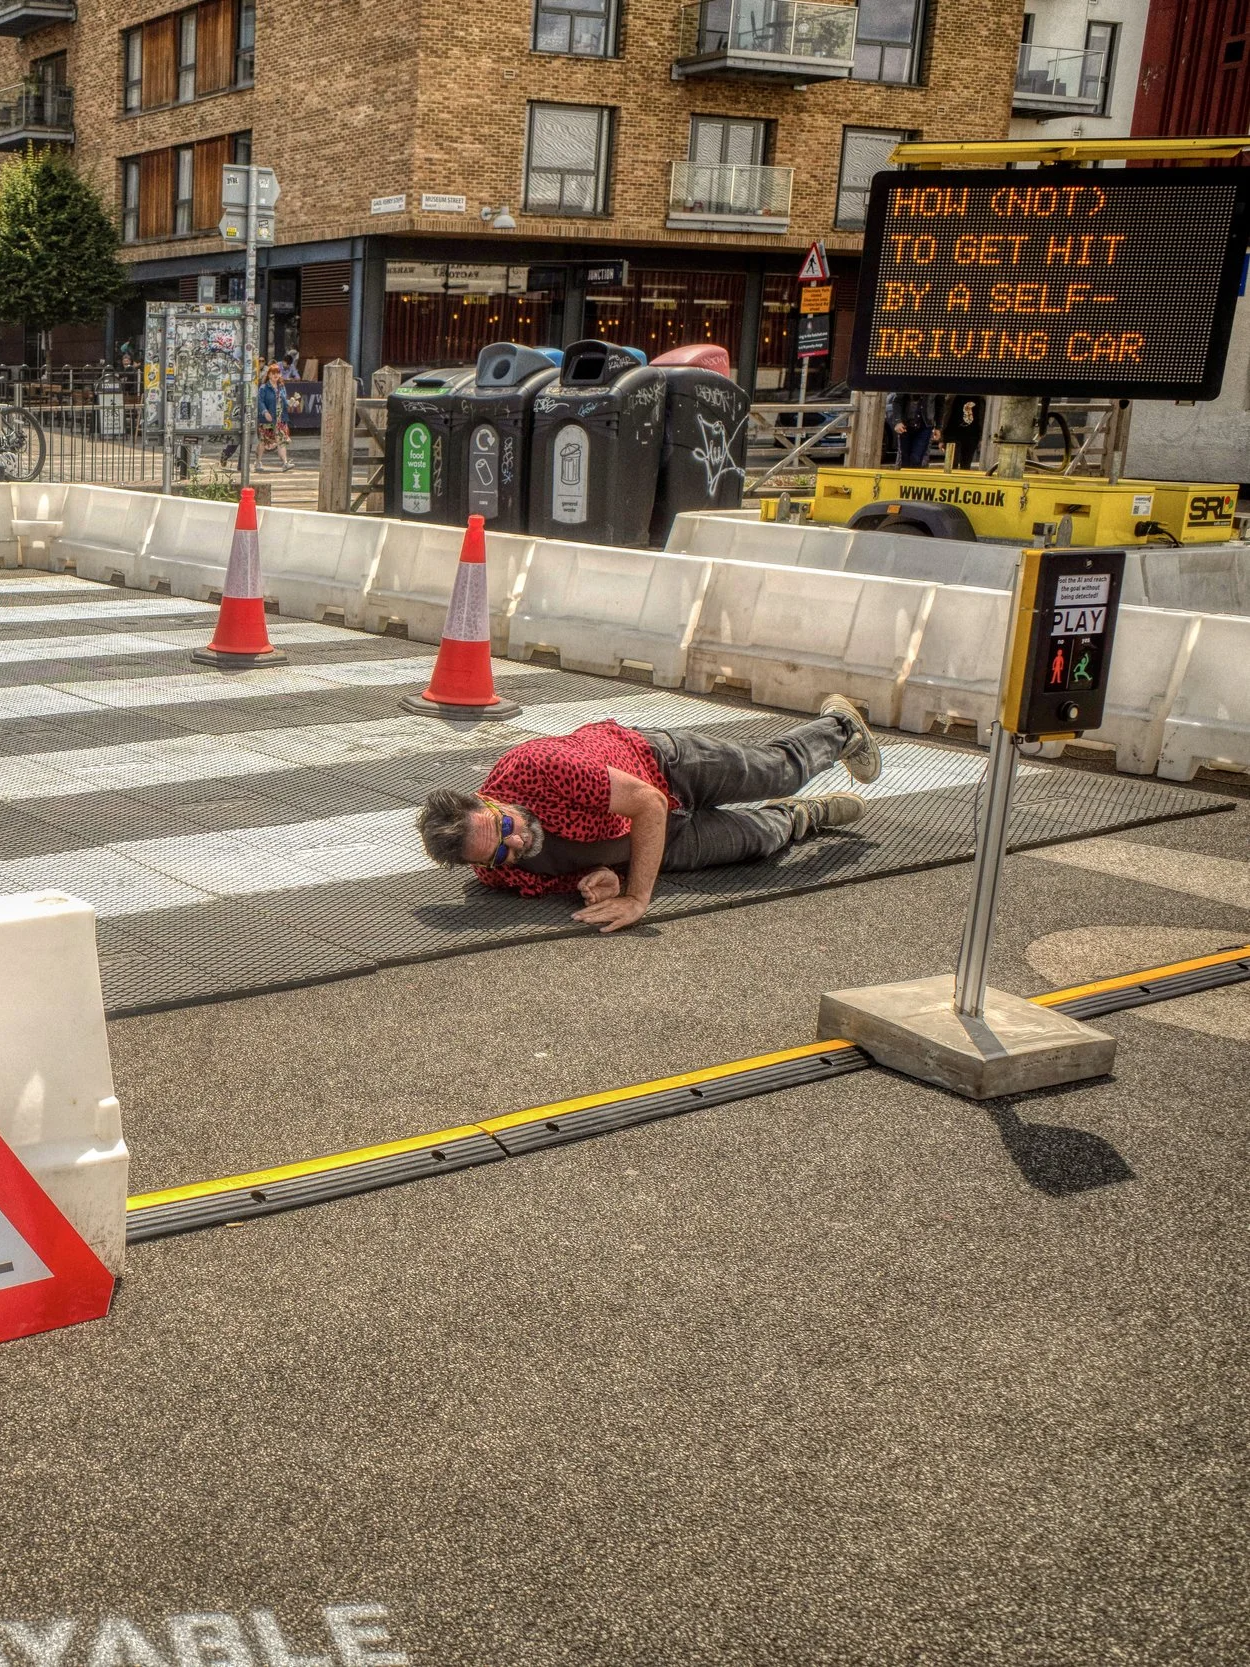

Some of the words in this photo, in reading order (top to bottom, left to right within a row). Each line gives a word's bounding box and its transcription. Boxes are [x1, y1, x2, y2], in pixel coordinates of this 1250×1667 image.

[893, 187, 968, 217] HOW
[990, 186, 1107, 217] (NOT)
[890, 233, 937, 264] TO
[953, 233, 1029, 265] GET
[1046, 235, 1126, 265] HIT
[881, 282, 931, 312] BY
[947, 283, 970, 312] A
[988, 283, 1119, 314] SELF-
[875, 327, 1049, 361] DRIVING
[1066, 332, 1146, 363] CAR
[407, 460, 427, 468] waste
[410, 449, 424, 459] food
[899, 485, 1006, 507] www.srl.co.uk
[1188, 496, 1233, 521] SRL
[1052, 609, 1103, 633] PLAY
